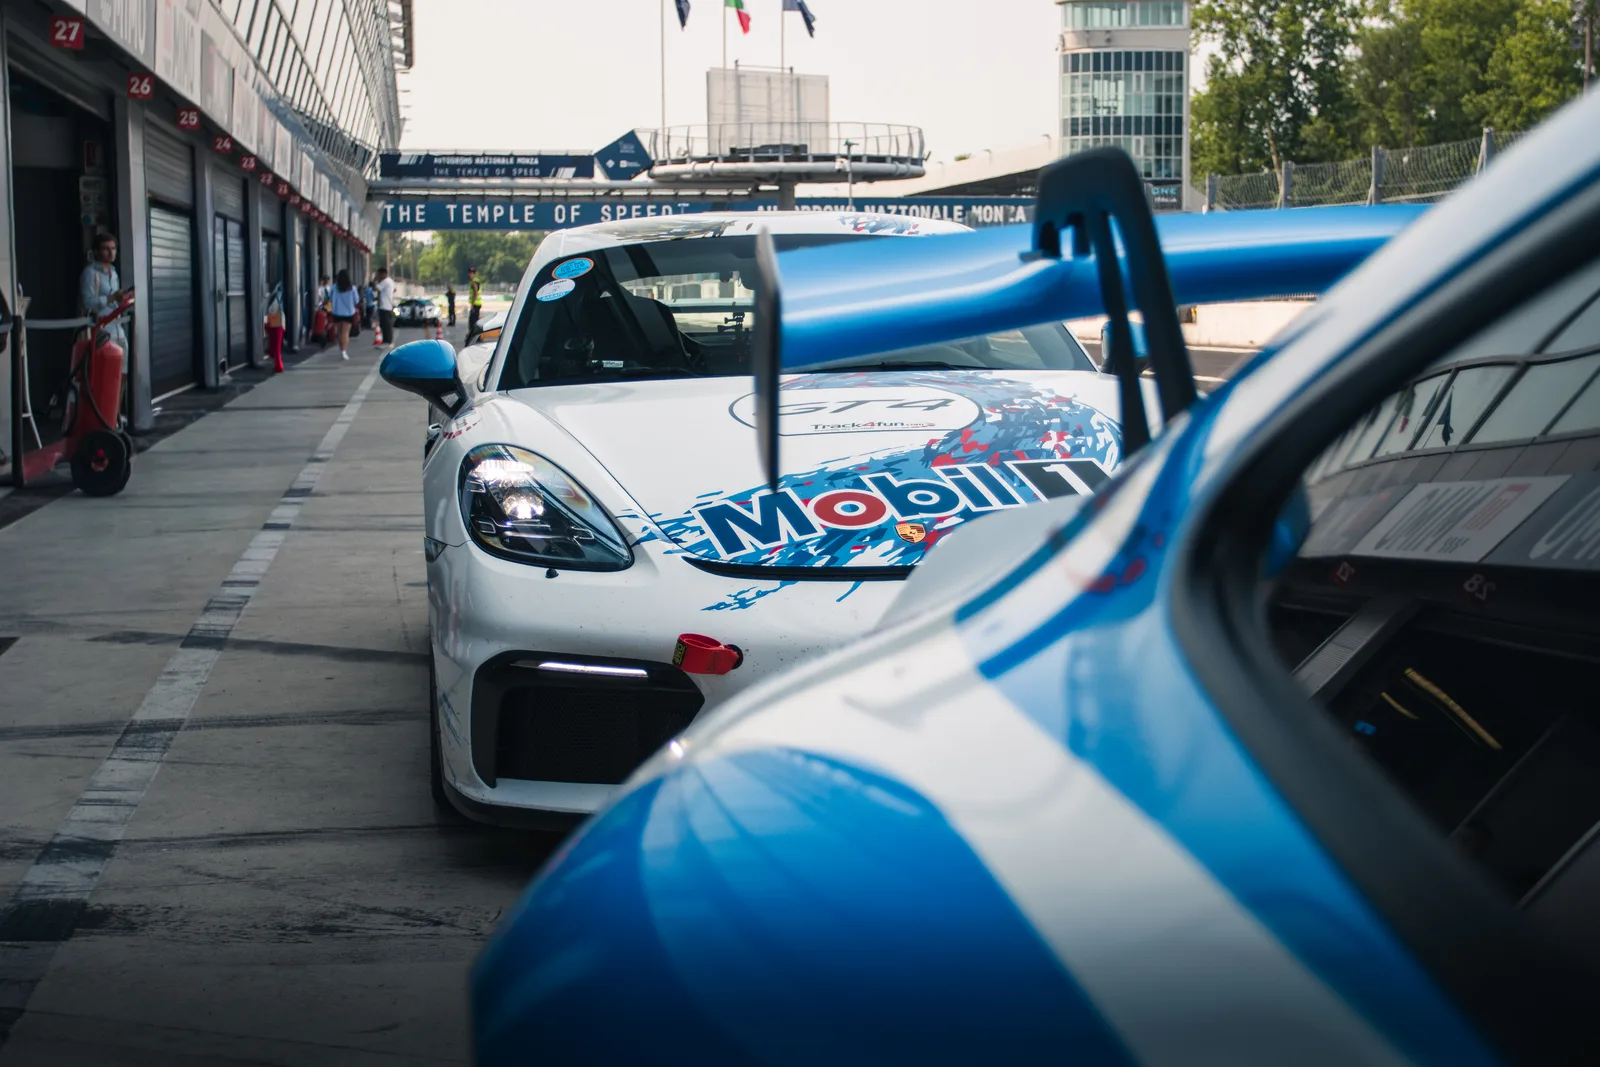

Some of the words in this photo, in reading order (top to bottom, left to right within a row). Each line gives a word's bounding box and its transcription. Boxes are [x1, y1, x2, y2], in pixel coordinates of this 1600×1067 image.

[54, 20, 80, 42] 27
[130, 76, 151, 95] 26
[180, 111, 198, 126] 25
[215, 137, 231, 150] 24
[474, 156, 514, 165] NAZIONALE
[516, 156, 539, 165] MONZA
[433, 168, 449, 176] THE
[456, 168, 488, 176] TEMPLE
[495, 168, 506, 176] OF
[512, 168, 540, 177] SPEED
[384, 204, 426, 223] THE
[446, 204, 535, 223] TEMPLE
[554, 204, 581, 223] OF
[601, 205, 673, 222] SPEED
[752, 398, 956, 417] GT4
[693, 464, 1025, 557] Mobil
